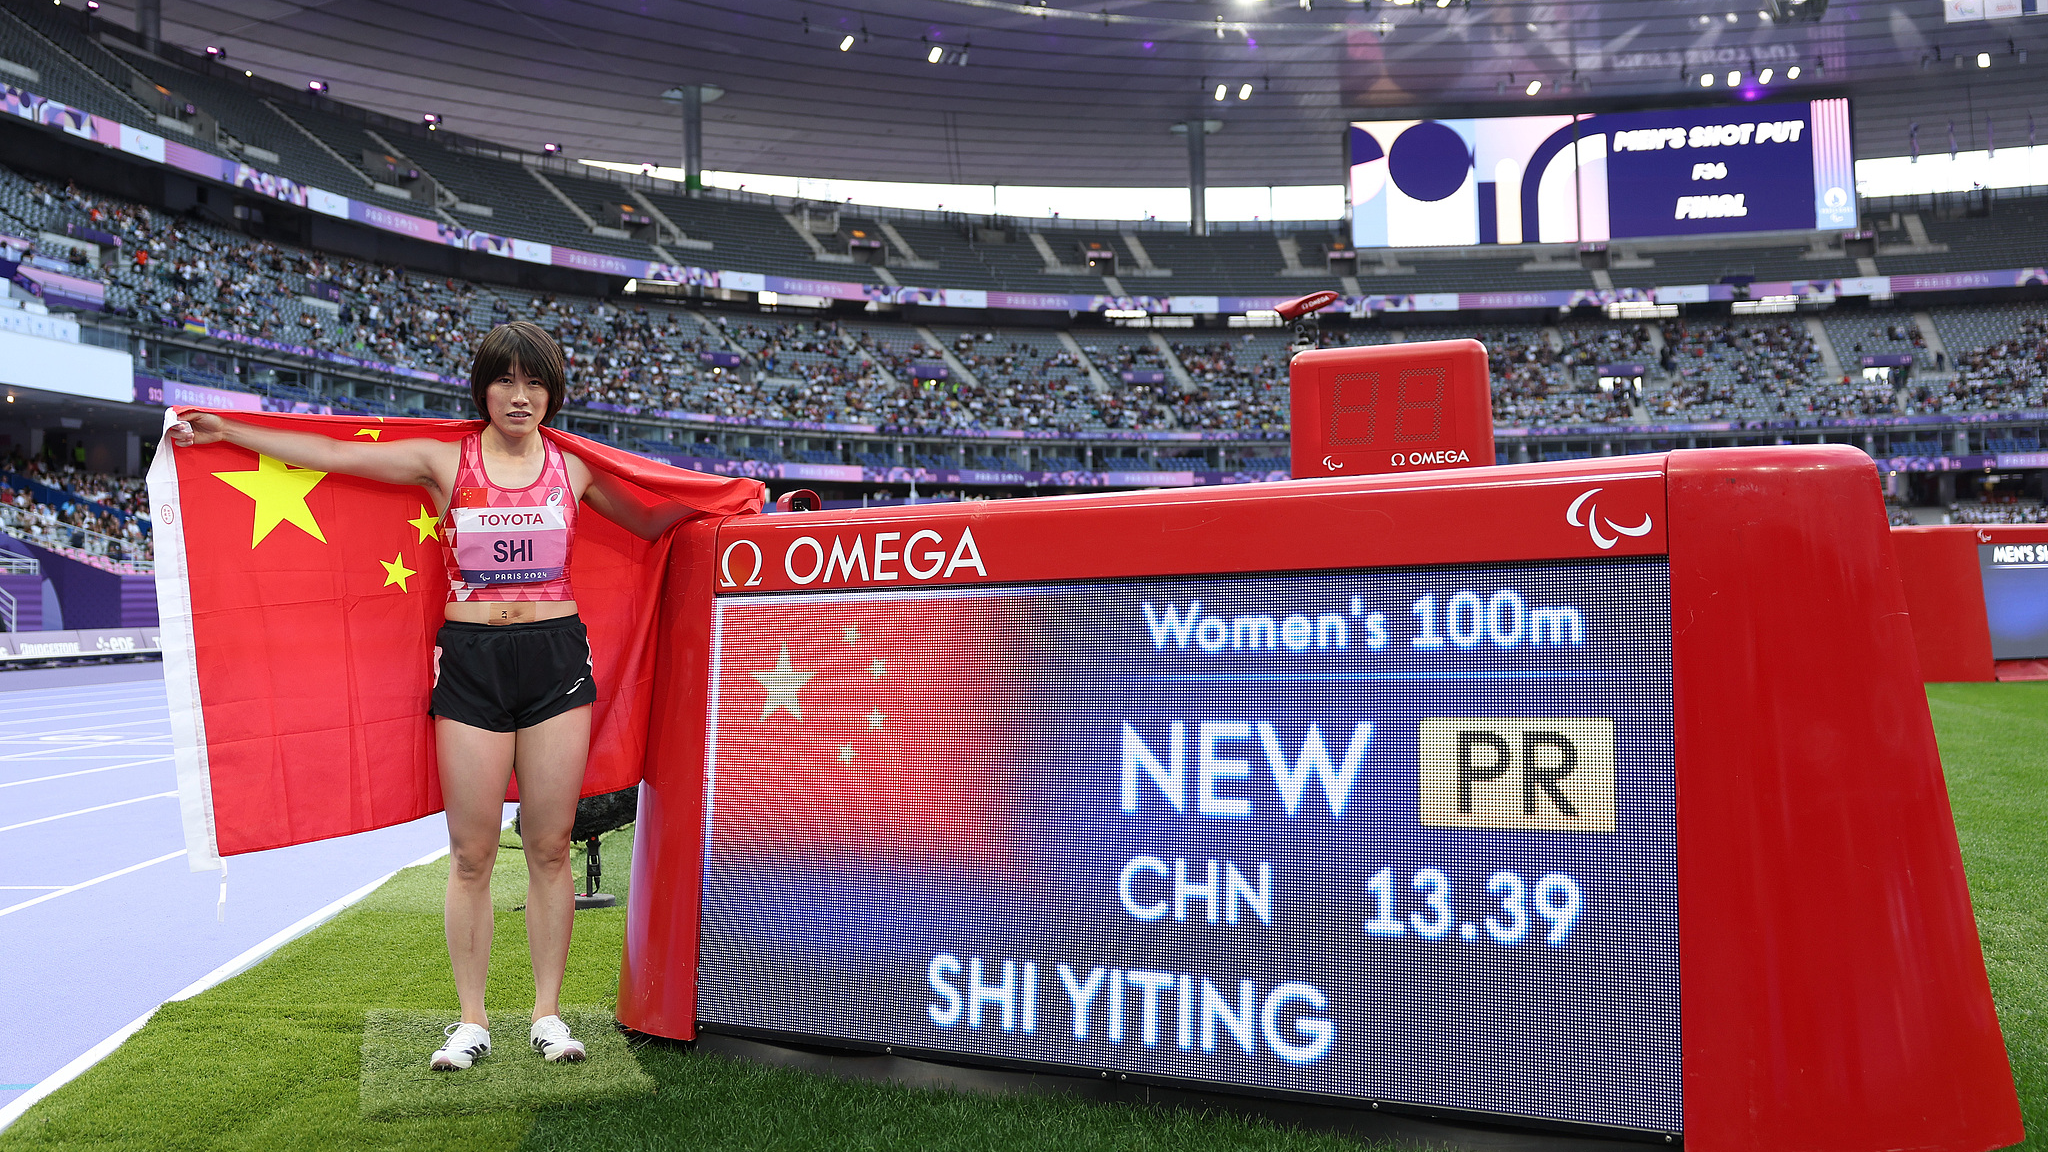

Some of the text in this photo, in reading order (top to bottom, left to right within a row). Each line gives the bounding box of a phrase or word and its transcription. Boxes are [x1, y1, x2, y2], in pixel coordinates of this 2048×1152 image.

[1613, 120, 1805, 152] MEN'S SHOT PUT
[1674, 193, 1748, 220] FINAL
[1307, 295, 1330, 307] OMEGA
[1409, 449, 1470, 466] OMEGA
[478, 513, 544, 526] TOYOTA
[493, 539, 533, 563] SHI
[784, 525, 988, 585] OMEGA
[1992, 544, 2034, 563] MEN'S
[495, 571, 547, 581] PARIS 2024
[1141, 589, 1585, 653] Women's 100m
[1121, 719, 1580, 818] NEW PR
[1118, 855, 1584, 947] CHN 13.39
[926, 954, 1337, 1065] SHI YITING
